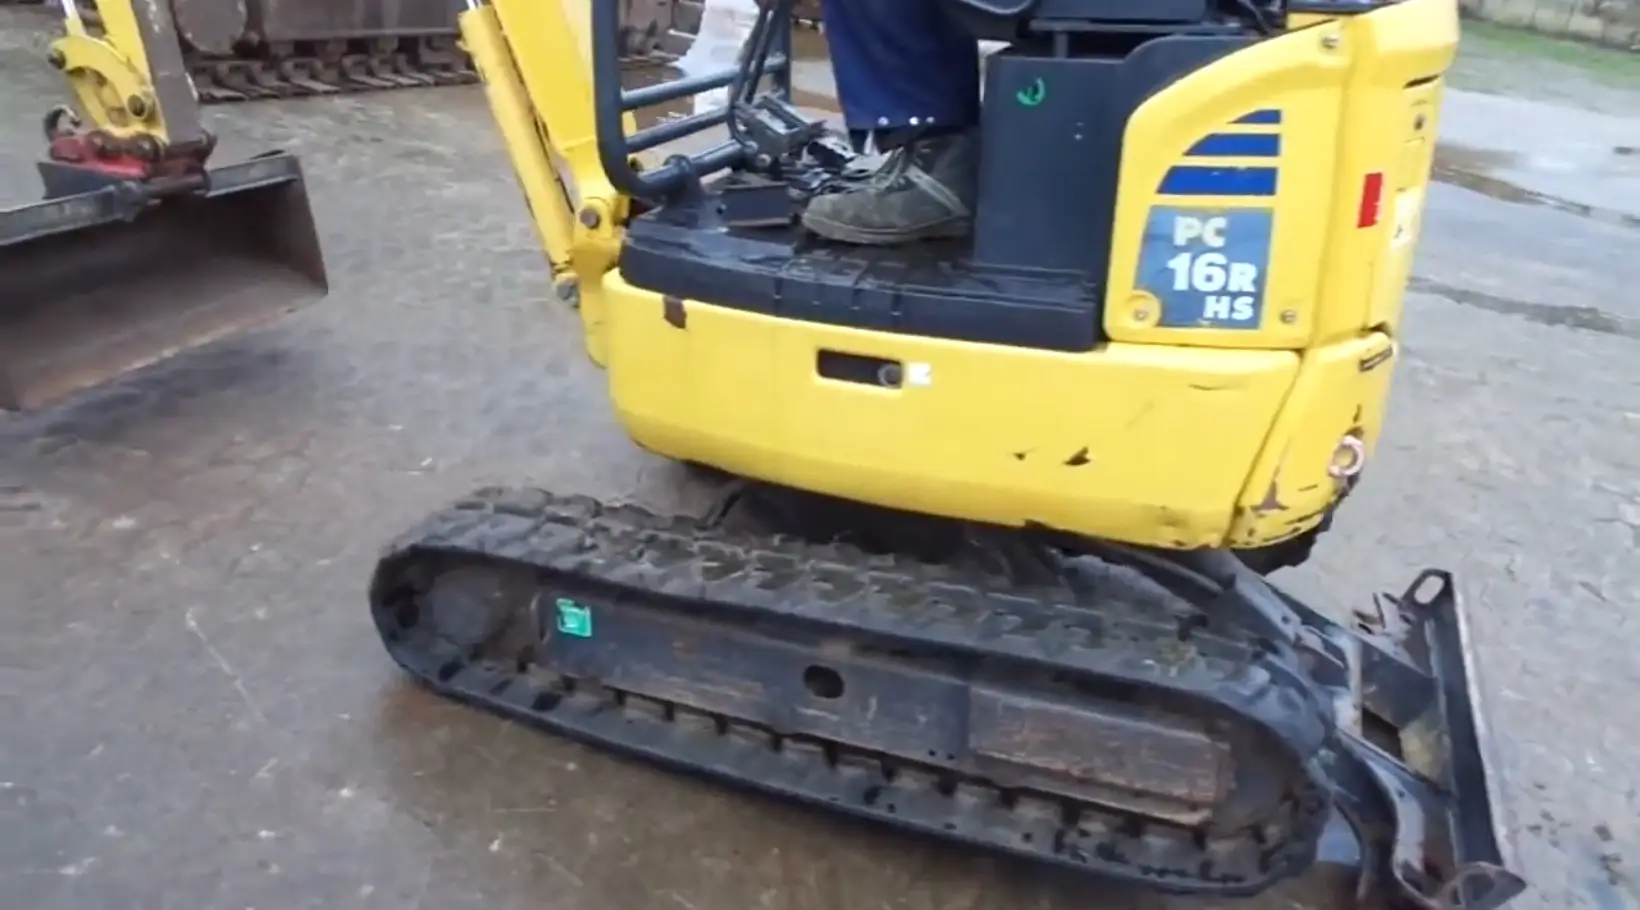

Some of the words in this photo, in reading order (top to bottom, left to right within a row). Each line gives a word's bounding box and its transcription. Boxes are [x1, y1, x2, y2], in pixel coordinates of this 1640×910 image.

[1173, 216, 1227, 247] PC
[1167, 252, 1258, 292] 16R
[1203, 295, 1254, 320] HS
